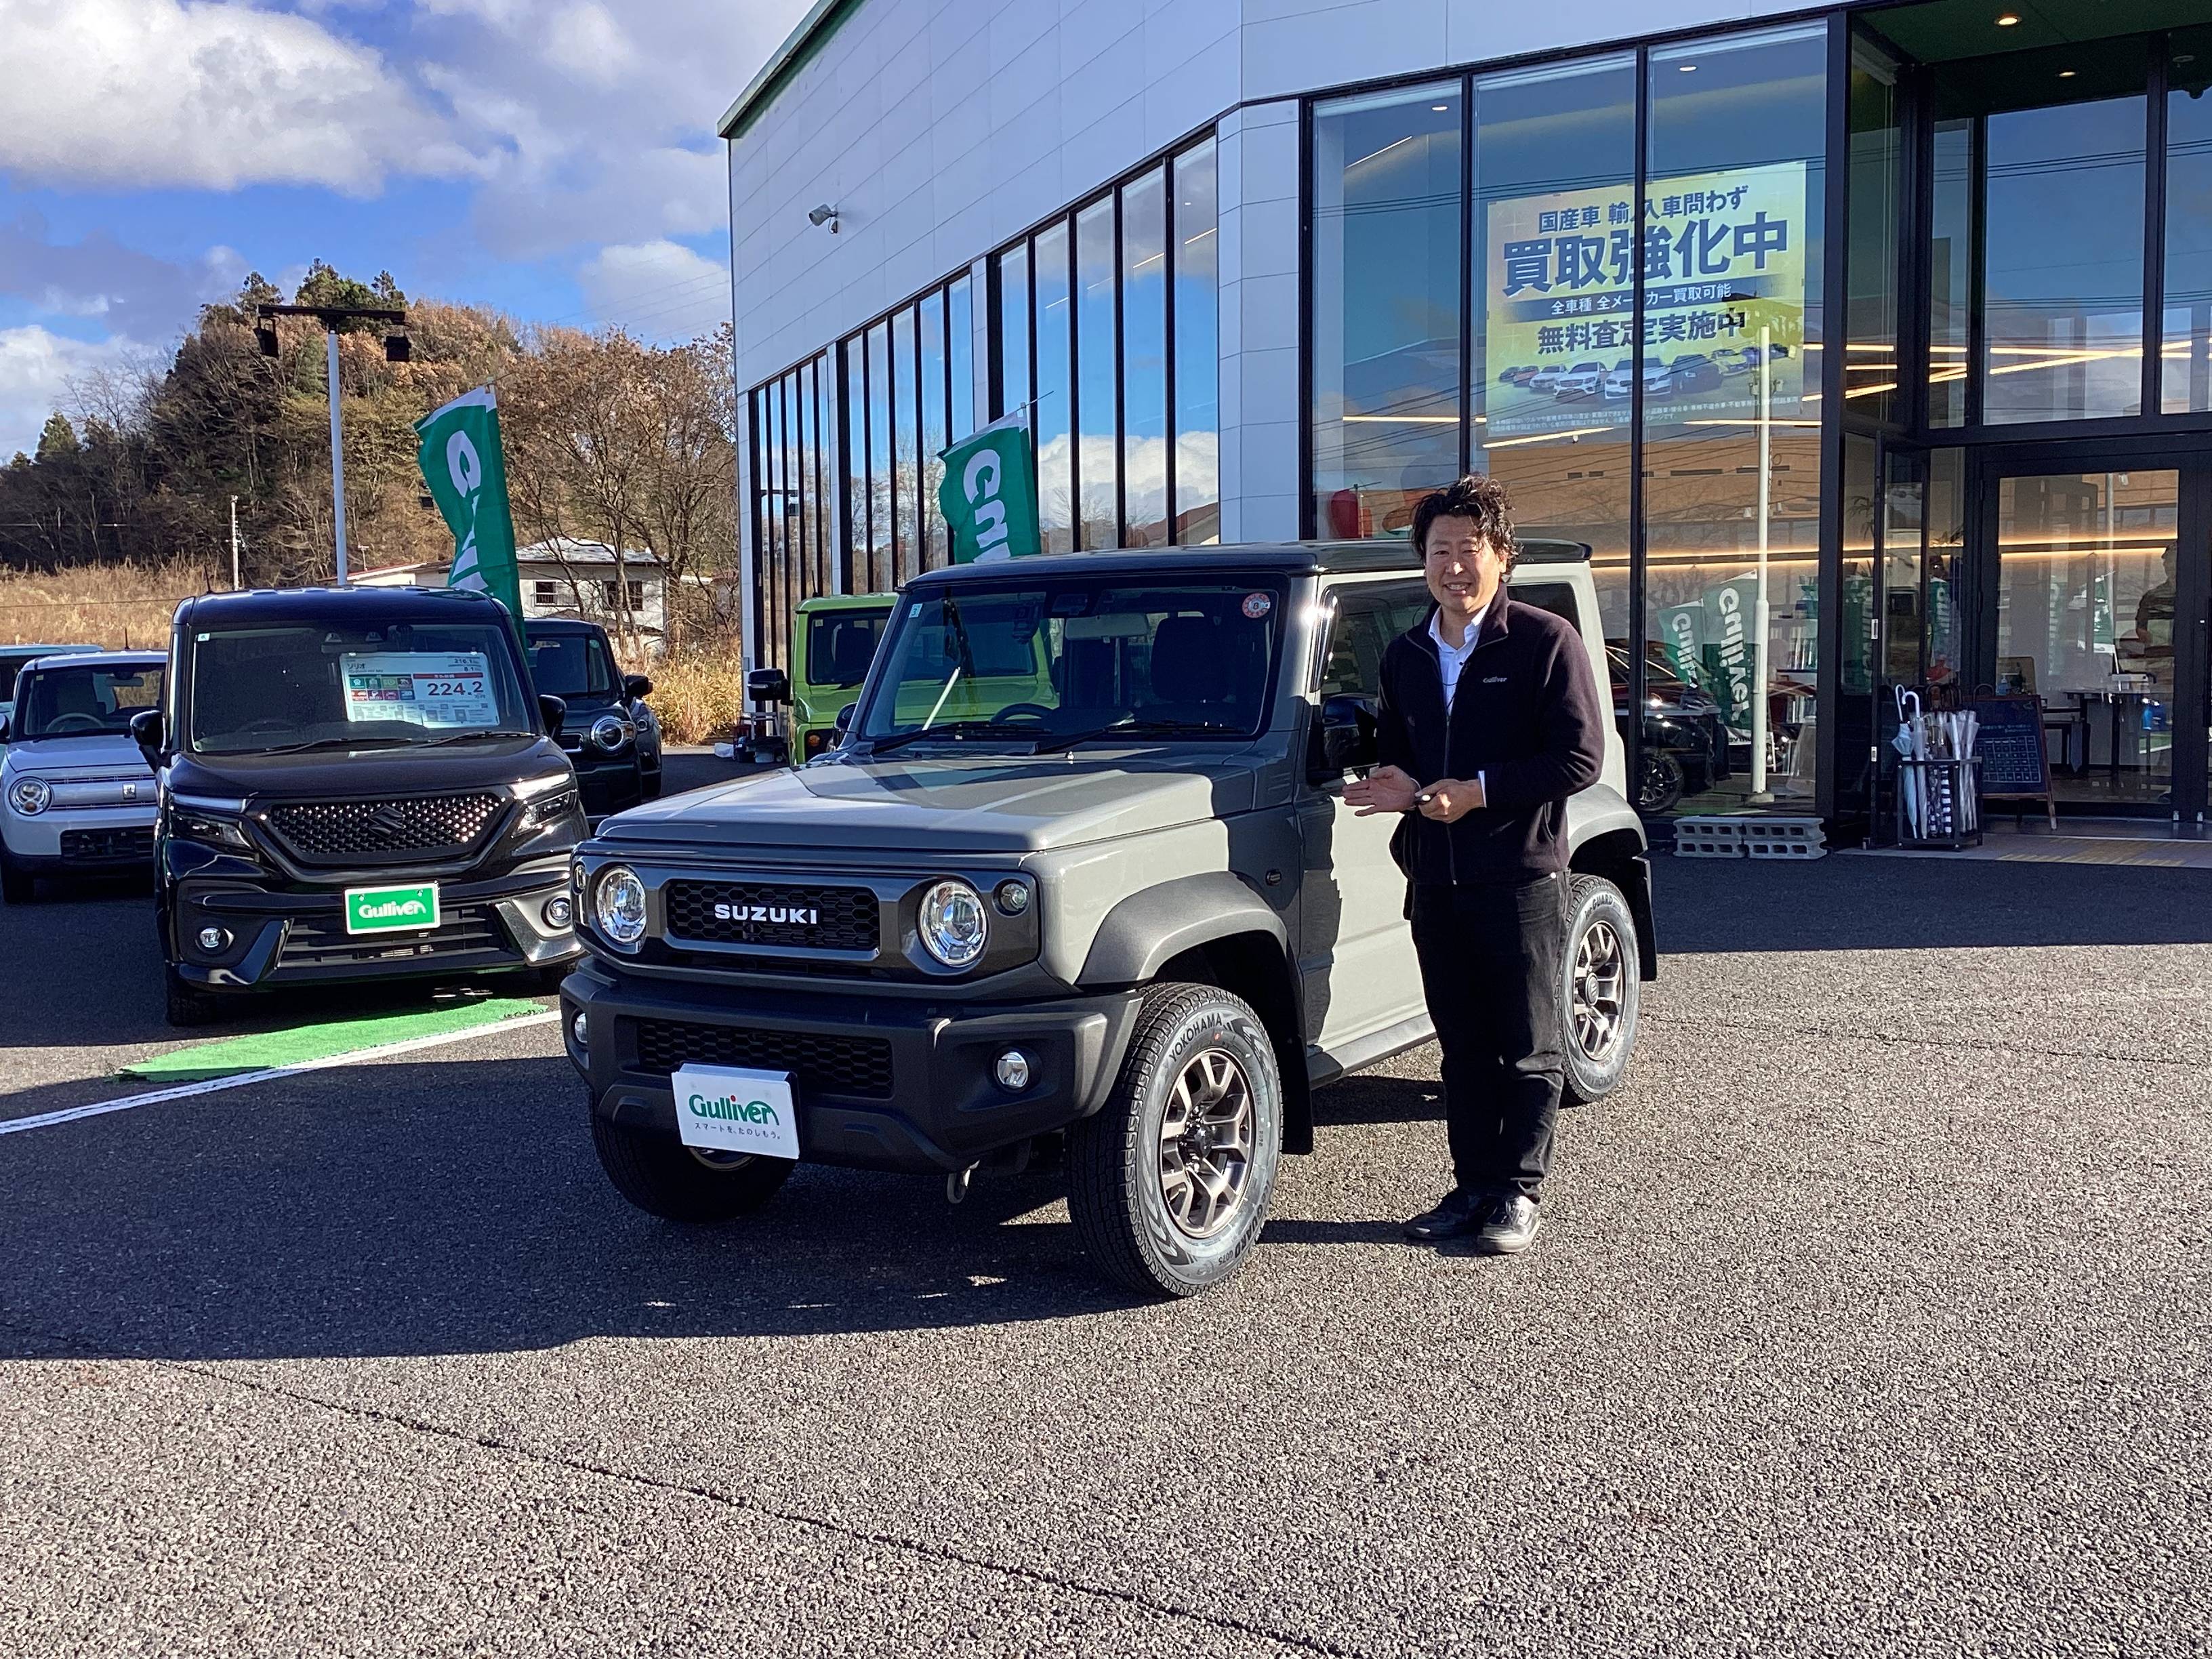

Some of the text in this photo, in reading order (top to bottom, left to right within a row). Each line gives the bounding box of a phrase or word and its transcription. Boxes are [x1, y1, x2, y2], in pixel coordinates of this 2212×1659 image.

[1539, 205, 1601, 233] 国産車
[1502, 211, 1788, 298] 買取強化中
[1551, 283, 1732, 315] 全車種 全メーカー買取可能
[1538, 308, 1746, 355] 無料査定実施中
[427, 681, 483, 696] 224.2
[359, 900, 427, 919] Gulliver
[714, 903, 817, 924] SUZUKI
[1169, 1012, 1223, 1062] YOKOHAMA
[689, 1094, 779, 1126] Gulliver
[695, 1122, 780, 1140] スマートを、たのしもう。
